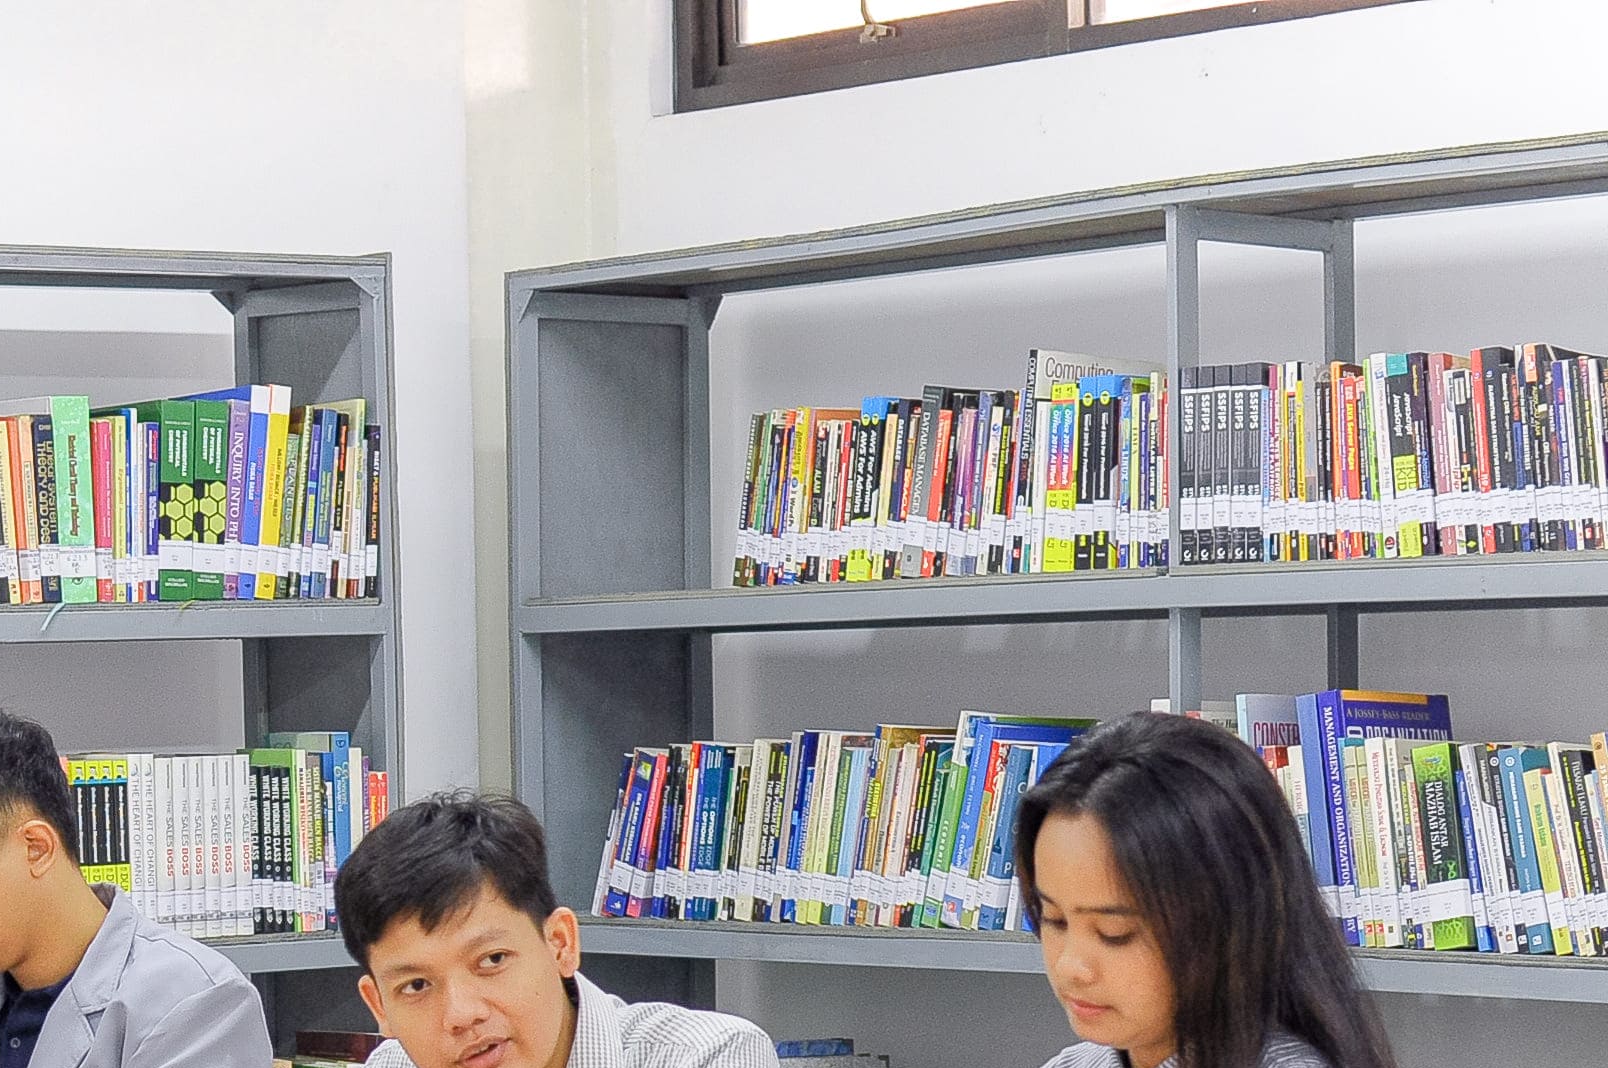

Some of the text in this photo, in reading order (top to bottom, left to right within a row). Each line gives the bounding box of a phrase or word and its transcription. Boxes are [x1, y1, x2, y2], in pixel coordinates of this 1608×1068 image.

[1045, 357, 1113, 380] Computing
[1021, 357, 1036, 459] COMPUTING ESSENTIALS
[1051, 409, 1060, 433] Office
[1184, 395, 1194, 433] SSFIPS
[1201, 394, 1211, 432] SSFIPS
[1217, 392, 1227, 429] SSFIPS
[1234, 392, 1244, 429] SSFIPS
[1249, 392, 1259, 429] SSFIPS
[1346, 403, 1354, 420] JAVA
[1392, 394, 1403, 437] JavaScript
[214, 427, 222, 473] FUNDAMENTALS
[894, 419, 904, 460] DATABASE
[919, 412, 931, 462] DATABASE
[1061, 409, 1072, 485] Office 2016 Work
[231, 431, 244, 517] INQUIRY INTO
[853, 430, 868, 513] AWS For Admins
[863, 430, 877, 512] AWS For Admins
[1049, 464, 1057, 485] Work
[132, 779, 140, 797] THE
[1323, 706, 1351, 885] MANAGEMENT AND ORGANIZATION
[145, 779, 153, 847] THE HEART OF
[181, 816, 189, 846] SALES
[224, 814, 232, 844] SALES
[242, 813, 250, 843] SALES
[250, 800, 259, 860] WORKING CLASS
[263, 800, 272, 860] WORKING CLASS
[272, 802, 281, 863] WORKING CLASS
[283, 802, 292, 863] WORKING CLASS
[699, 811, 709, 845] OPTIONS
[707, 811, 716, 844] OPTIONS
[1424, 782, 1443, 865] MAZHAB ISLAM
[1434, 781, 1448, 847] DIALOG ANTAR
[133, 835, 141, 848] OF
[166, 817, 174, 877] SALES BOSS
[195, 815, 203, 875] SALES BOSS
[210, 815, 219, 874] SALES BOSS
